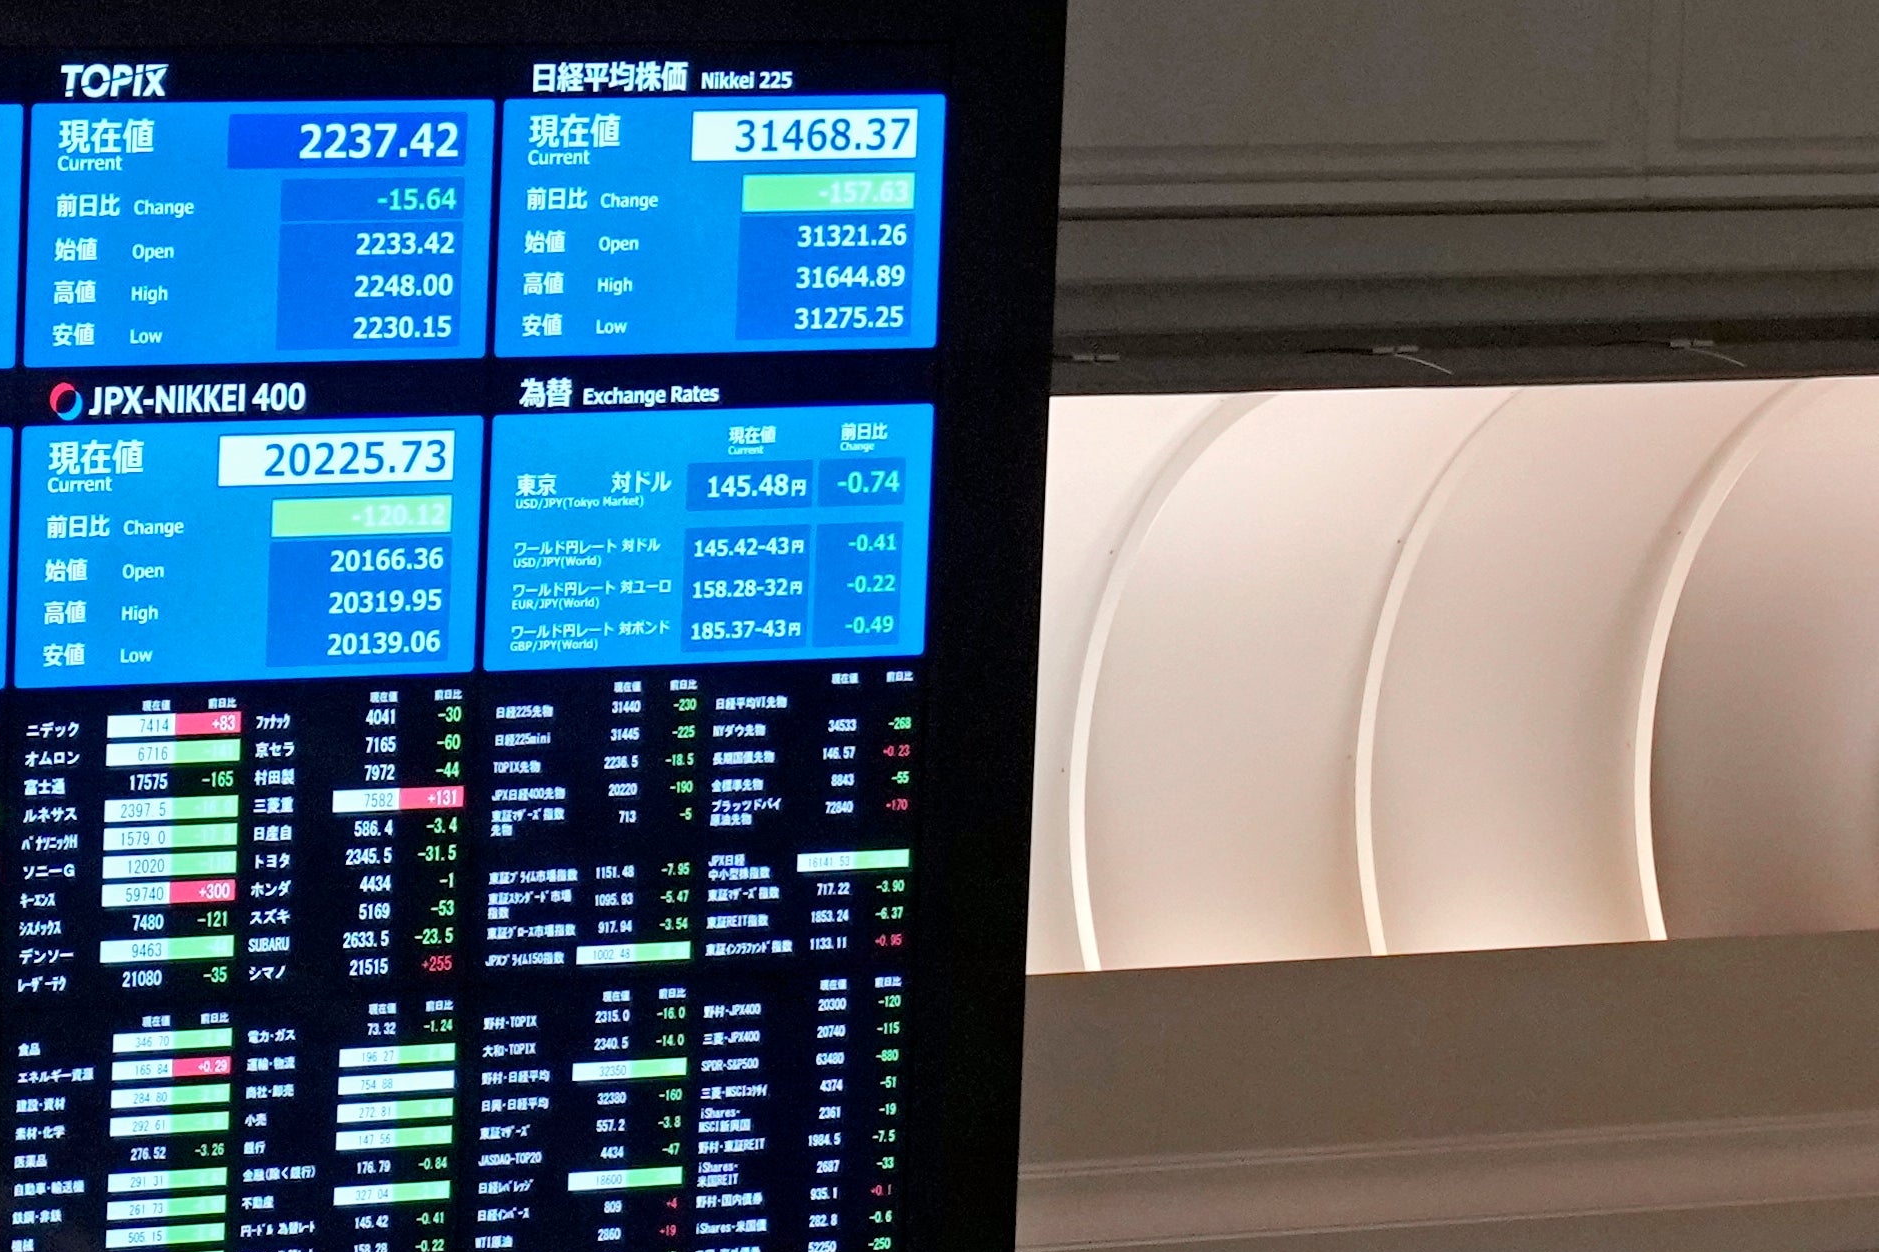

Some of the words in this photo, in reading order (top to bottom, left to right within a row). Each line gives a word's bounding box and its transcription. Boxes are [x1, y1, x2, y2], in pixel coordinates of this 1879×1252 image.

[61, 64, 168, 98] TOPIX
[533, 61, 688, 92] 日経平均株価
[701, 71, 754, 89] Nikkei
[759, 71, 792, 89] 225
[59, 119, 154, 153] 現在値
[300, 123, 458, 158] 2237.42
[529, 114, 620, 148] 現在値
[735, 118, 911, 152] 31468.37
[57, 194, 120, 217] 前日比
[134, 200, 194, 218] Change
[377, 188, 457, 210] -15.64
[528, 188, 587, 210] 前日比
[601, 193, 658, 211] Change
[356, 232, 454, 255] 2233.42
[798, 224, 906, 247] 31321.26
[55, 238, 97, 261] 始値
[355, 274, 453, 297] 2248.00
[797, 265, 905, 288] 31644.89
[54, 280, 95, 304] 高値
[132, 286, 167, 304] High
[354, 316, 451, 339] 2230.15
[795, 306, 903, 329] 31275.25
[53, 323, 94, 346] 安値
[89, 384, 245, 415] JPX-NIKKEI
[252, 383, 305, 411] 400
[519, 378, 572, 407] 為替
[583, 387, 666, 407] Exchange
[49, 440, 144, 474] 現在値
[264, 440, 446, 477] 20225.73
[516, 474, 556, 496] 東京
[611, 471, 671, 493] 対ドル
[837, 470, 900, 493] -0.74
[848, 533, 896, 551] -0.41
[331, 548, 443, 572] 20166.36
[847, 574, 895, 593] -0.22
[329, 589, 441, 614] 20319.95
[845, 615, 894, 634] -0.49
[328, 630, 440, 655] 20139.06
[130, 773, 168, 790] 17575
[198, 883, 230, 899] +300
[248, 936, 290, 952] SUBARU
[349, 958, 388, 976] 21515
